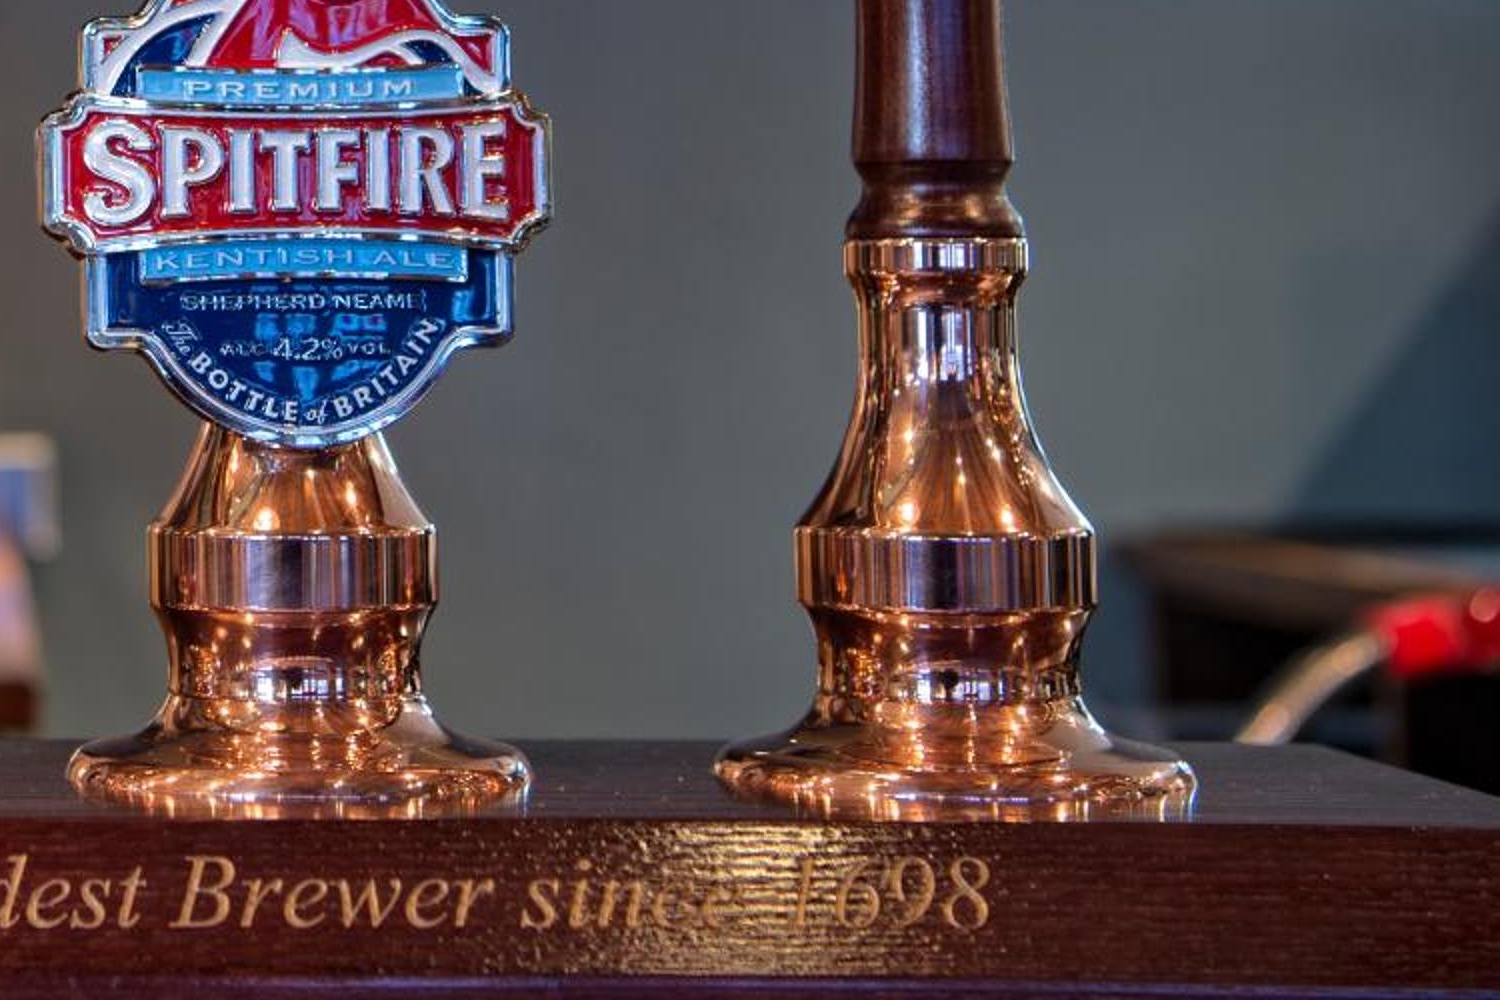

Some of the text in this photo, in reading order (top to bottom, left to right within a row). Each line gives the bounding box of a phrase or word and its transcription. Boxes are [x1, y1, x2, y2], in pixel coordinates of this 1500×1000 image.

[183, 80, 414, 99] PREMIUM
[82, 119, 511, 225] SPITFIRE
[155, 246, 454, 271] KENTISH ALE
[180, 293, 421, 311] SHEPHERD NEAME
[272, 338, 343, 361] 4.2%
[347, 343, 391, 355] VOL
[161, 317, 440, 424] The BOTTLE of BRITAIN
[169, 853, 500, 930] Brewer
[520, 857, 745, 930] since
[786, 853, 993, 932] 1698
